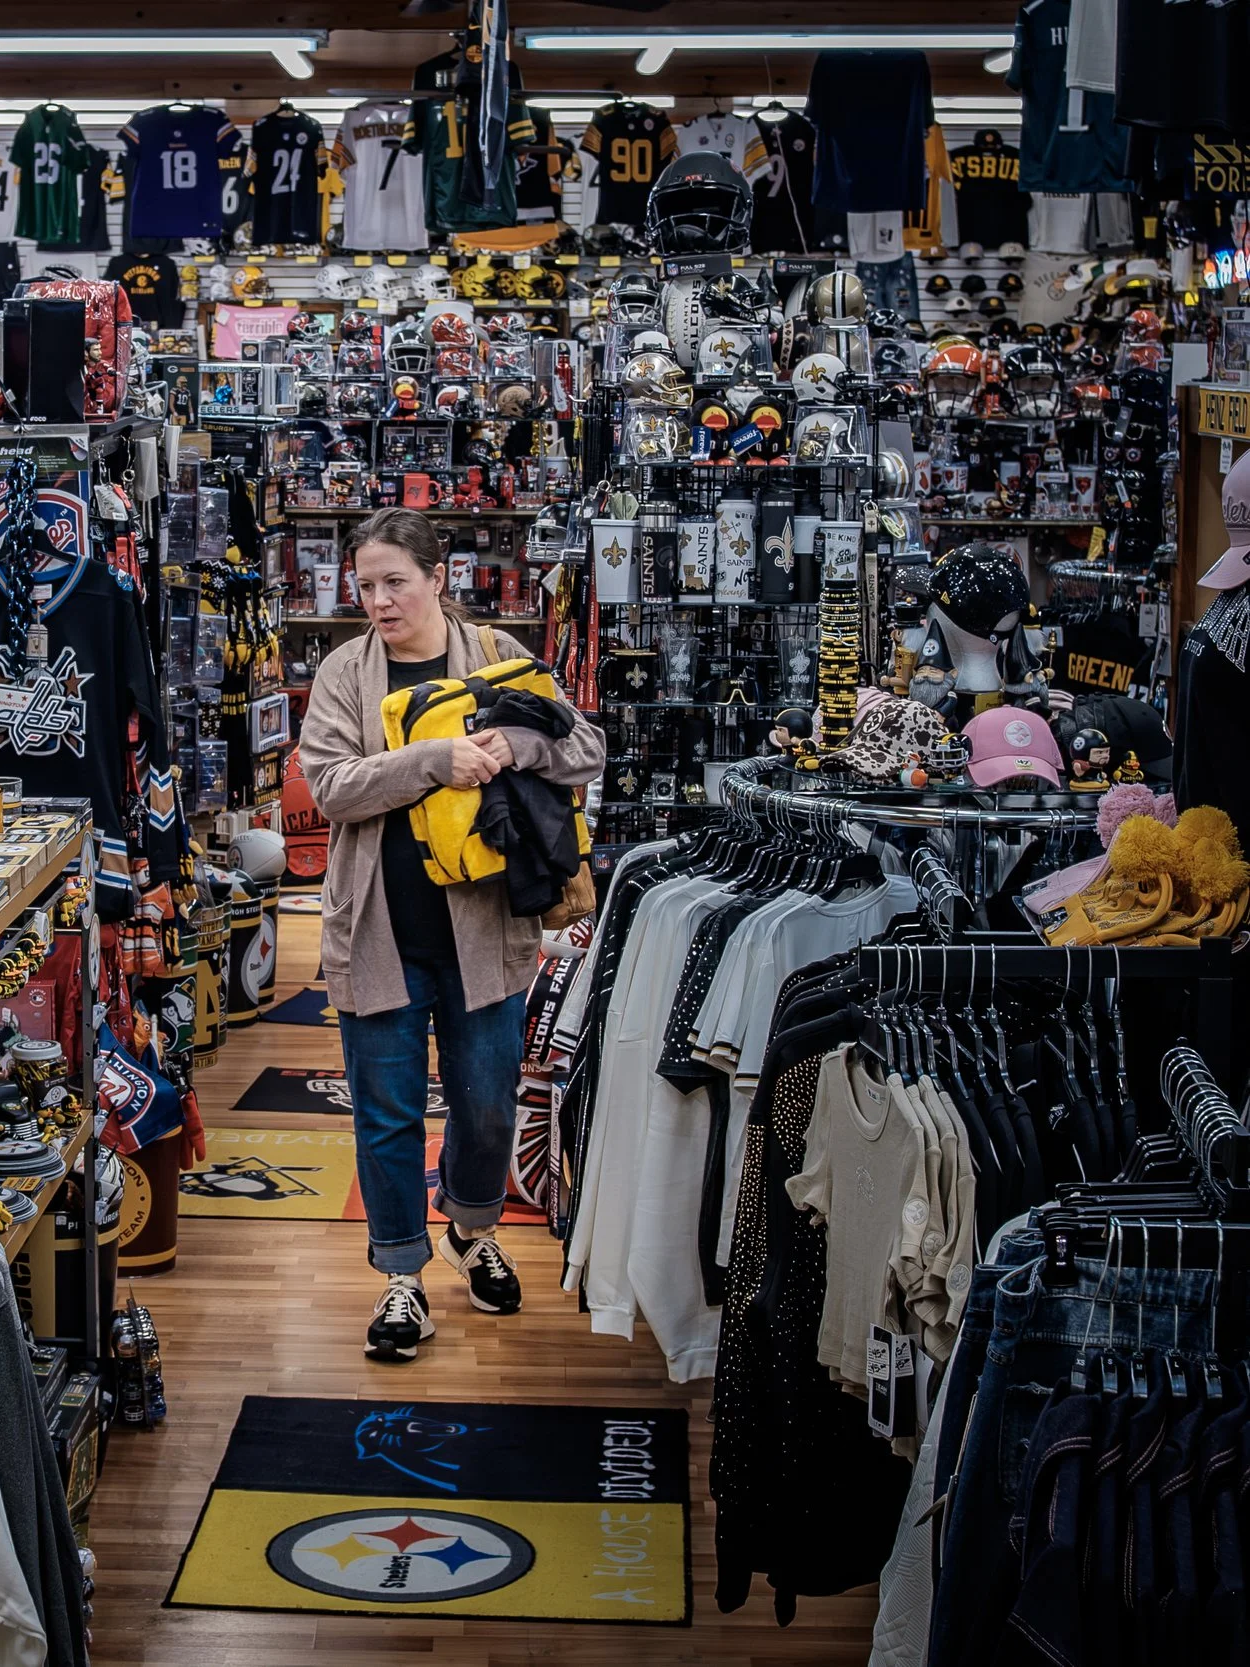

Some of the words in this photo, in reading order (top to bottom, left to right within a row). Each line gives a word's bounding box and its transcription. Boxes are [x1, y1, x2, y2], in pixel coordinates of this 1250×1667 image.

[159, 150, 198, 190] 18
[380, 140, 403, 191] 7
[609, 138, 654, 184] 90
[698, 526, 709, 575] SAINTS
[838, 533, 858, 543] KIND
[642, 535, 655, 598] SAINTS
[726, 559, 753, 567] SAINTS
[117, 1210, 146, 1242] TEAM
[1075, 1358, 1086, 1367] XS
[1107, 1357, 1114, 1366] S
[1136, 1362, 1144, 1370] M
[1209, 1364, 1219, 1372] XL
[600, 1419, 659, 1500] DIVIDED!
[593, 1509, 652, 1577] HOUSE
[379, 1554, 414, 1590] Steelers
